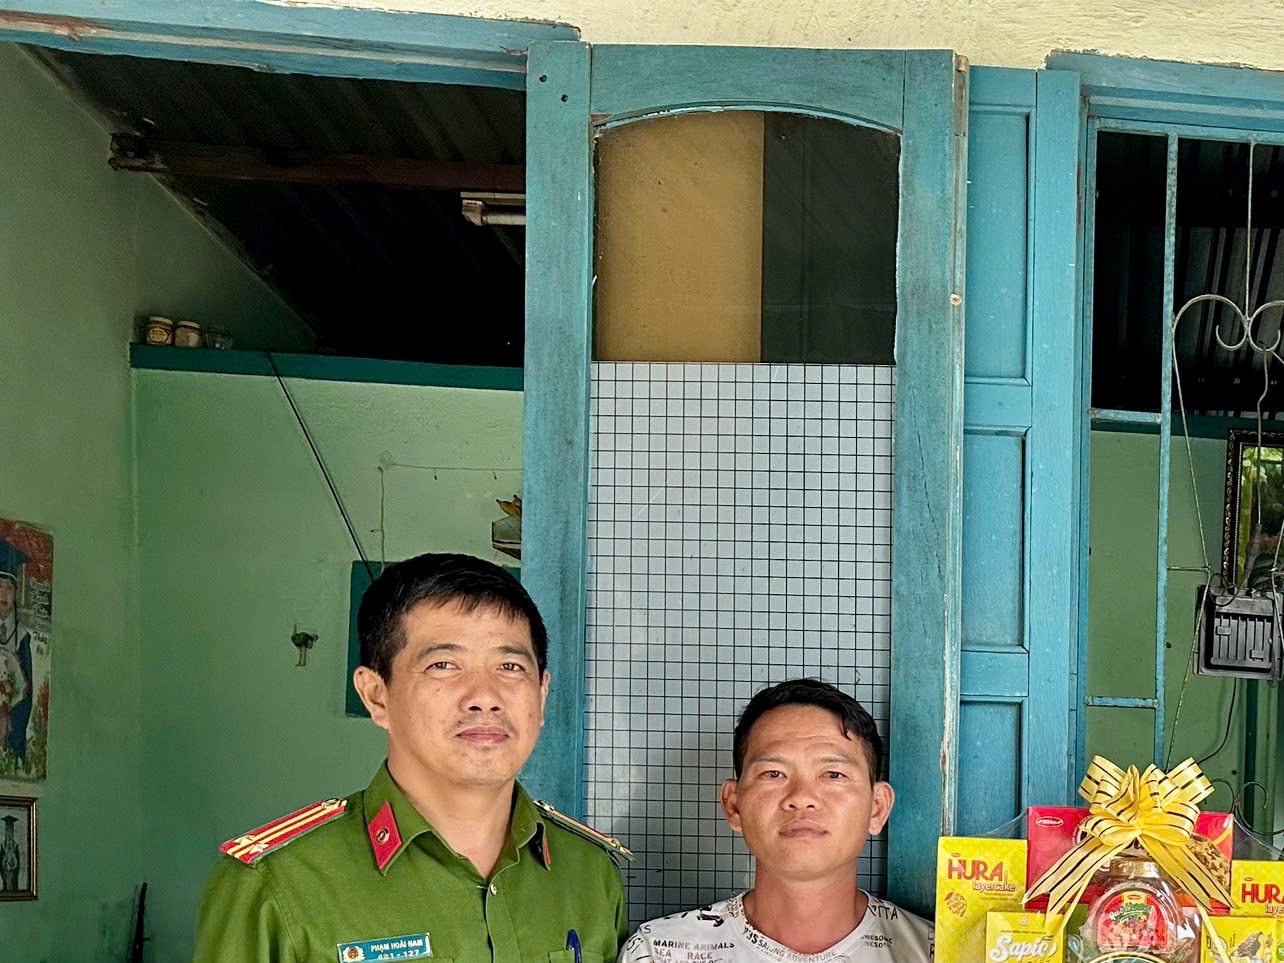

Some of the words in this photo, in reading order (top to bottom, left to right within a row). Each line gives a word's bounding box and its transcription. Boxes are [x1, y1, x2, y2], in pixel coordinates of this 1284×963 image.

[948, 859, 1003, 881] HURA
[973, 876, 1015, 893] layercake
[653, 939, 690, 949] MARINE
[687, 952, 712, 960] RACE
